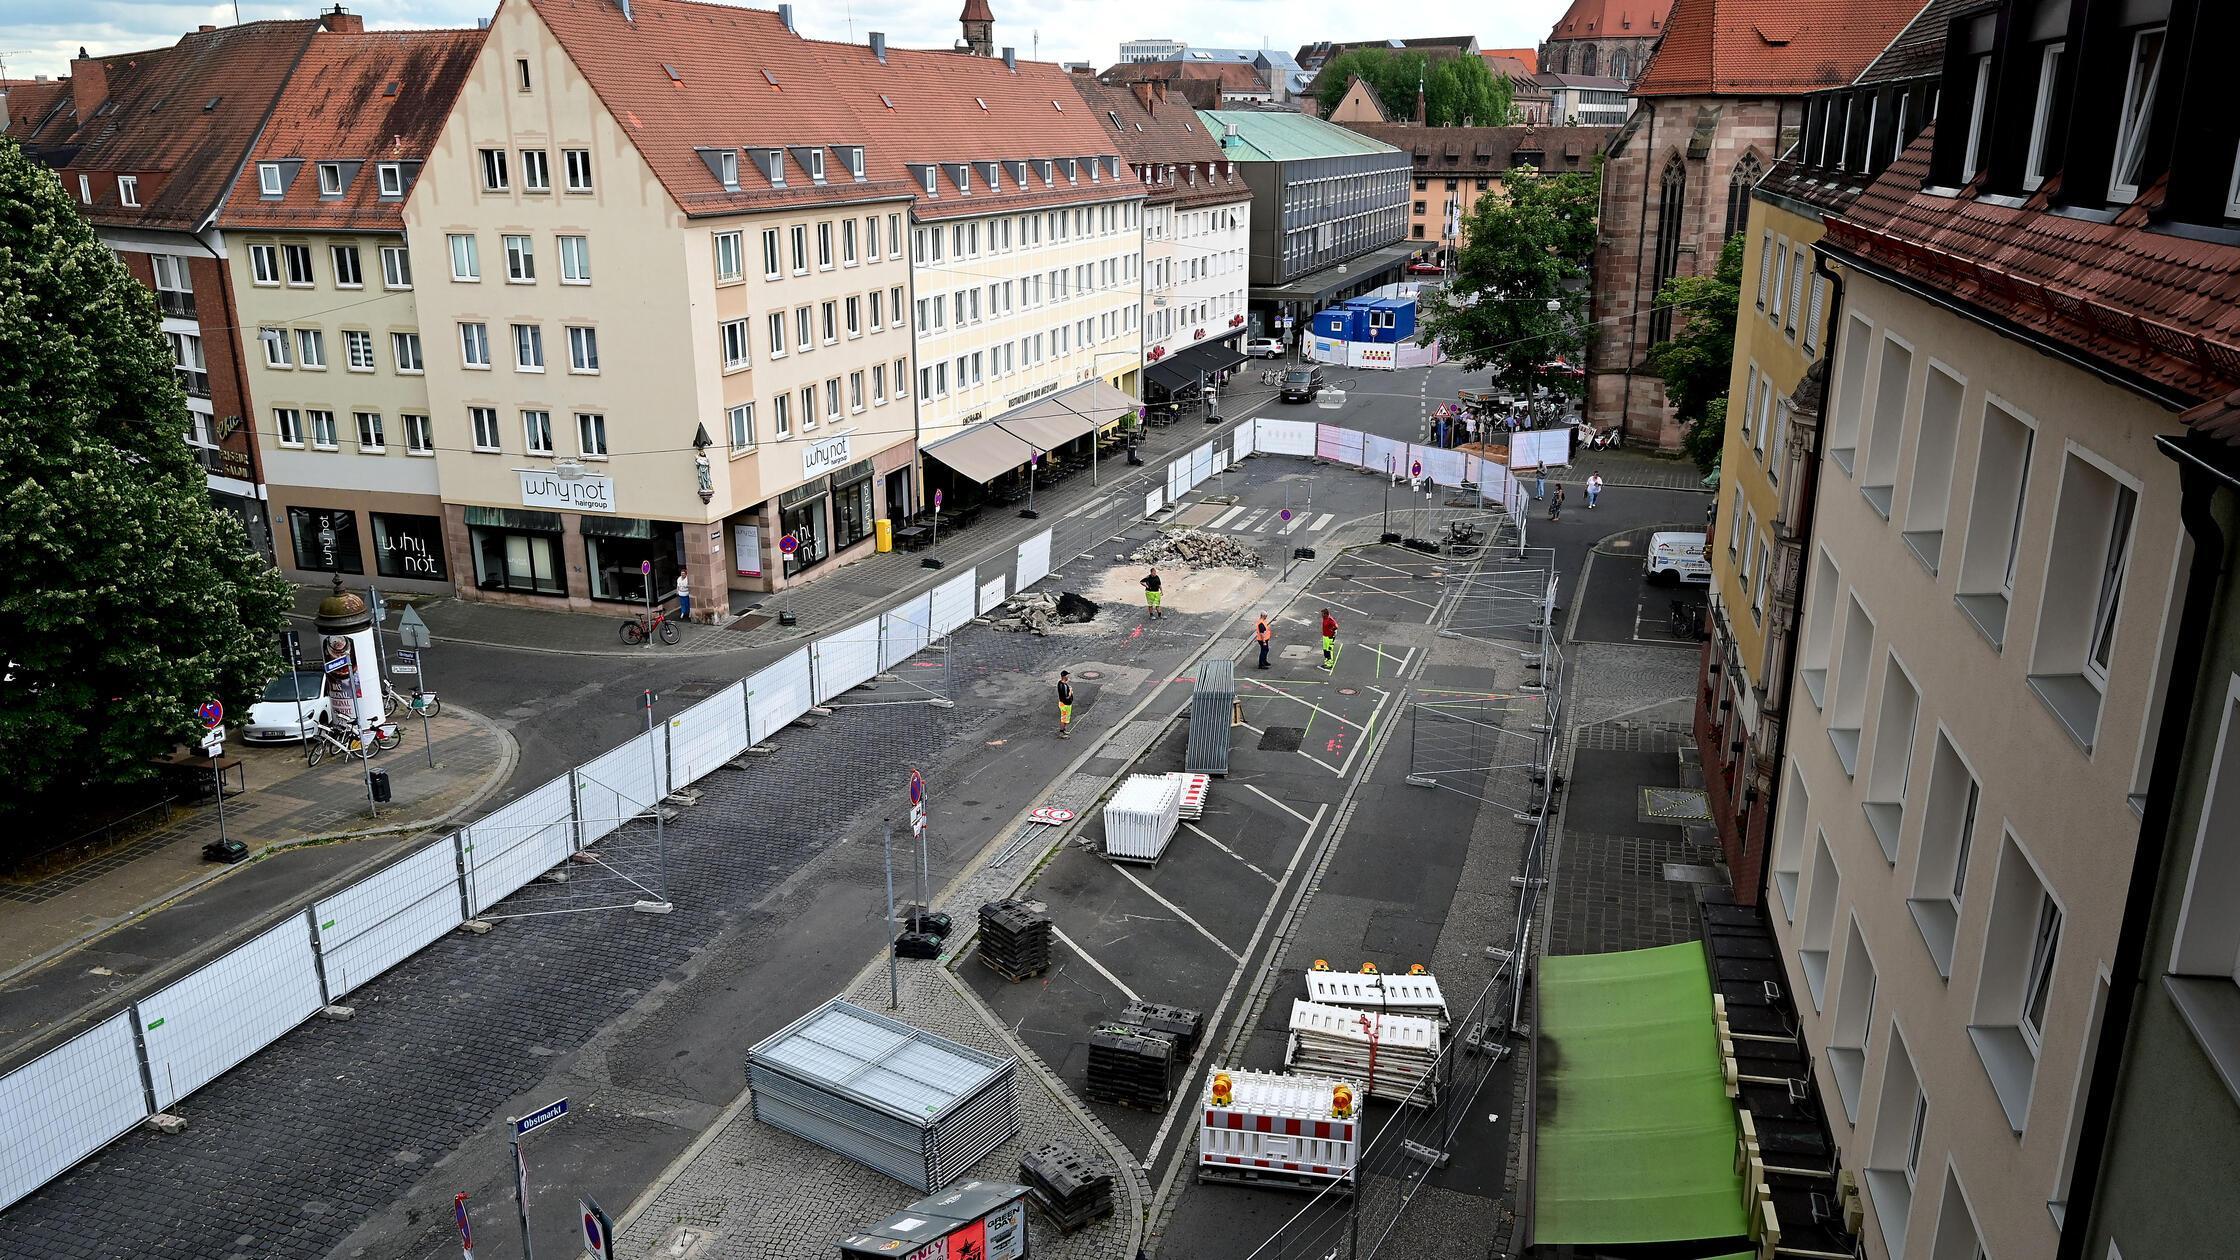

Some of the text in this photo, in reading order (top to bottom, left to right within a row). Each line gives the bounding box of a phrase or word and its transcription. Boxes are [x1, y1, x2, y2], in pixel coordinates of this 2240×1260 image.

[805, 438, 847, 468] why not
[526, 477, 606, 501] why not
[575, 500, 608, 509] hairgroup
[319, 515, 334, 566] why not
[381, 532, 426, 556] why
[405, 553, 437, 573] not
[523, 1105, 562, 1129] Obstmarkt
[987, 1206, 1020, 1228] GREEN
[994, 1215, 1013, 1231] DAY
